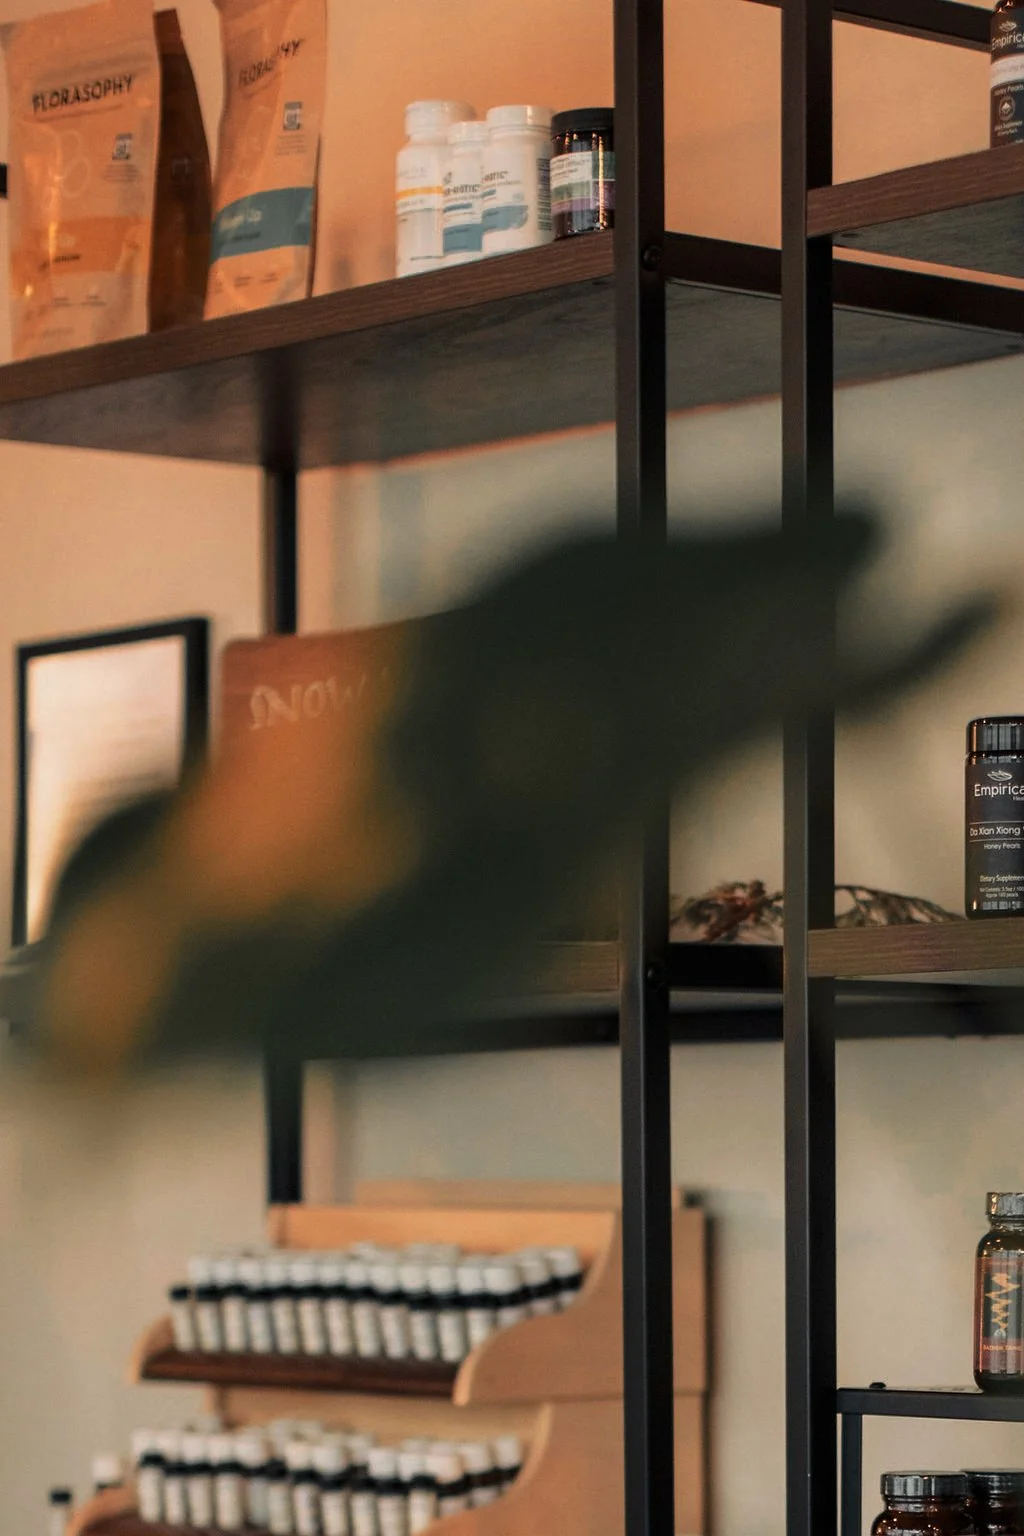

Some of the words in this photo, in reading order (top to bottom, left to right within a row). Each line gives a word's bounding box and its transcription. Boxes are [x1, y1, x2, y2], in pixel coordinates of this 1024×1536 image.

[31, 74, 133, 114] FLORASOPHY
[979, 826, 995, 836] Xian
[996, 826, 1021, 837] Xiong
